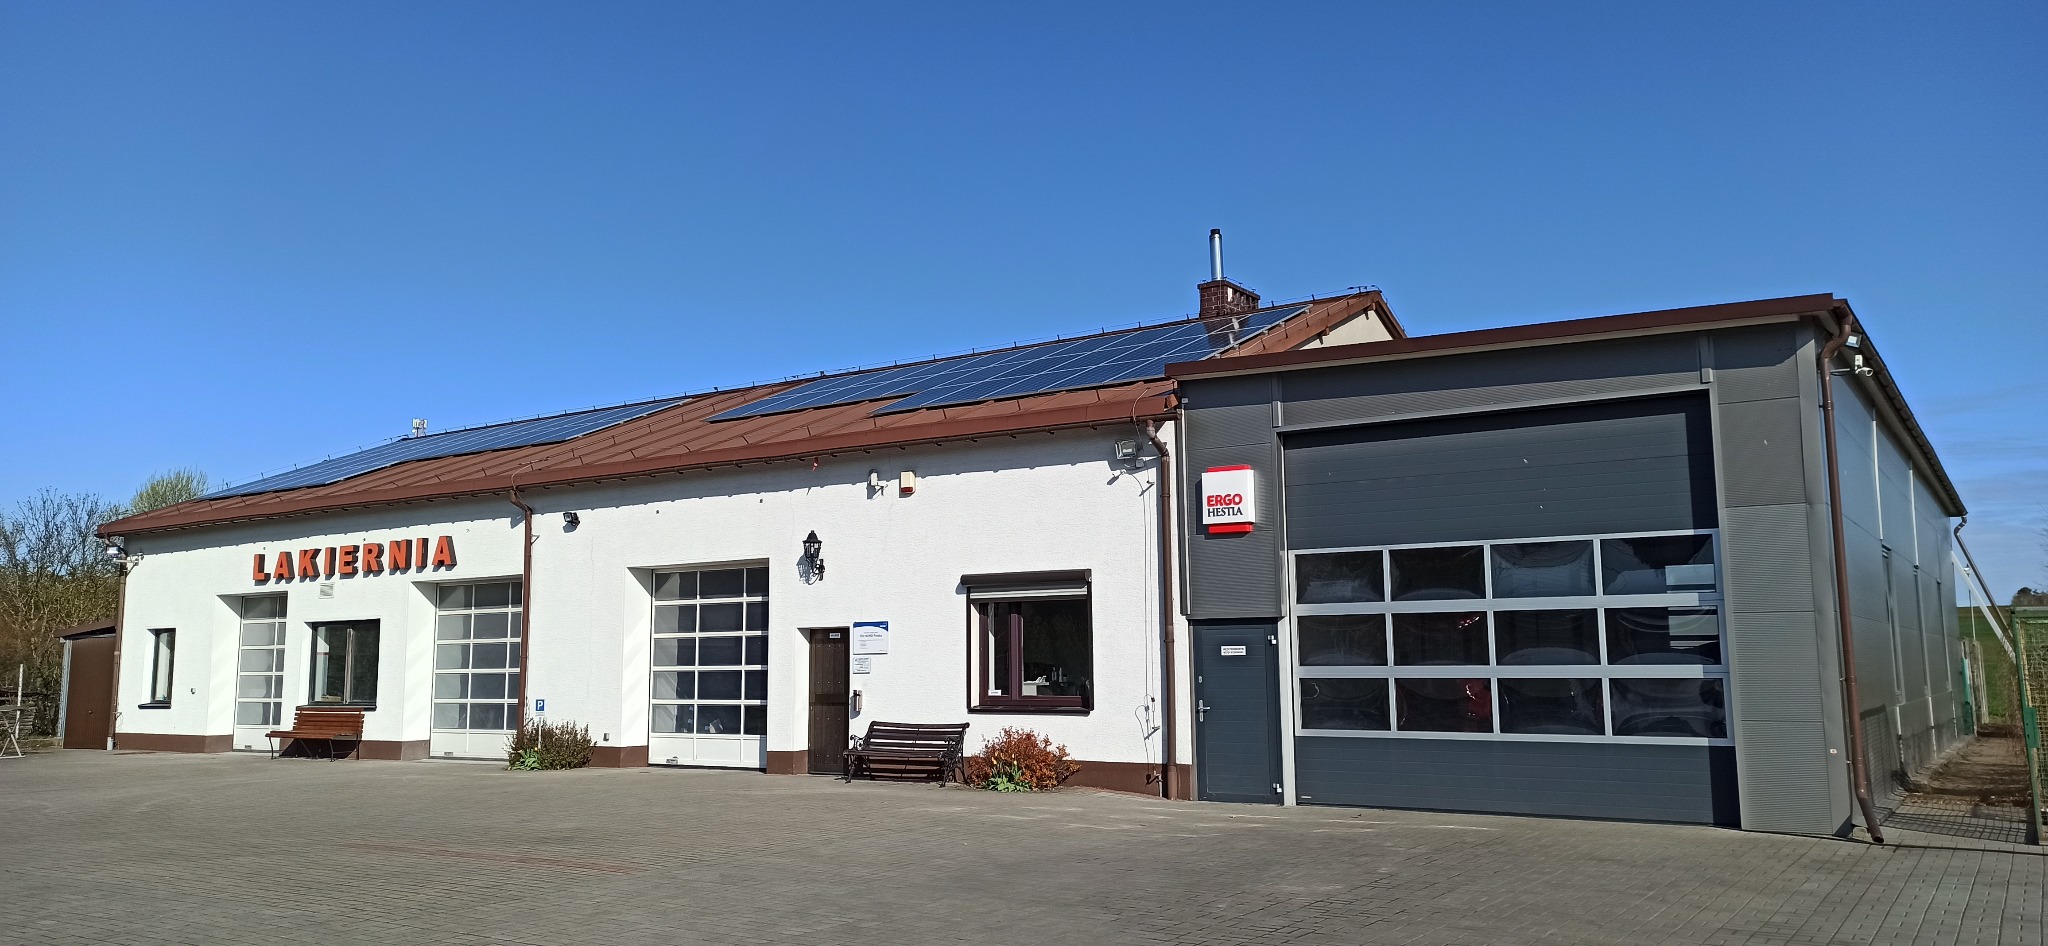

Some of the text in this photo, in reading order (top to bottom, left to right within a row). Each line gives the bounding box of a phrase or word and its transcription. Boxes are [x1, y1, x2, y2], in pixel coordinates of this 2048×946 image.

[1206, 493, 1243, 507] ERGO
[1207, 506, 1244, 517] HESTIA
[253, 535, 457, 582] LAKIERNIA
[537, 700, 544, 711] P
